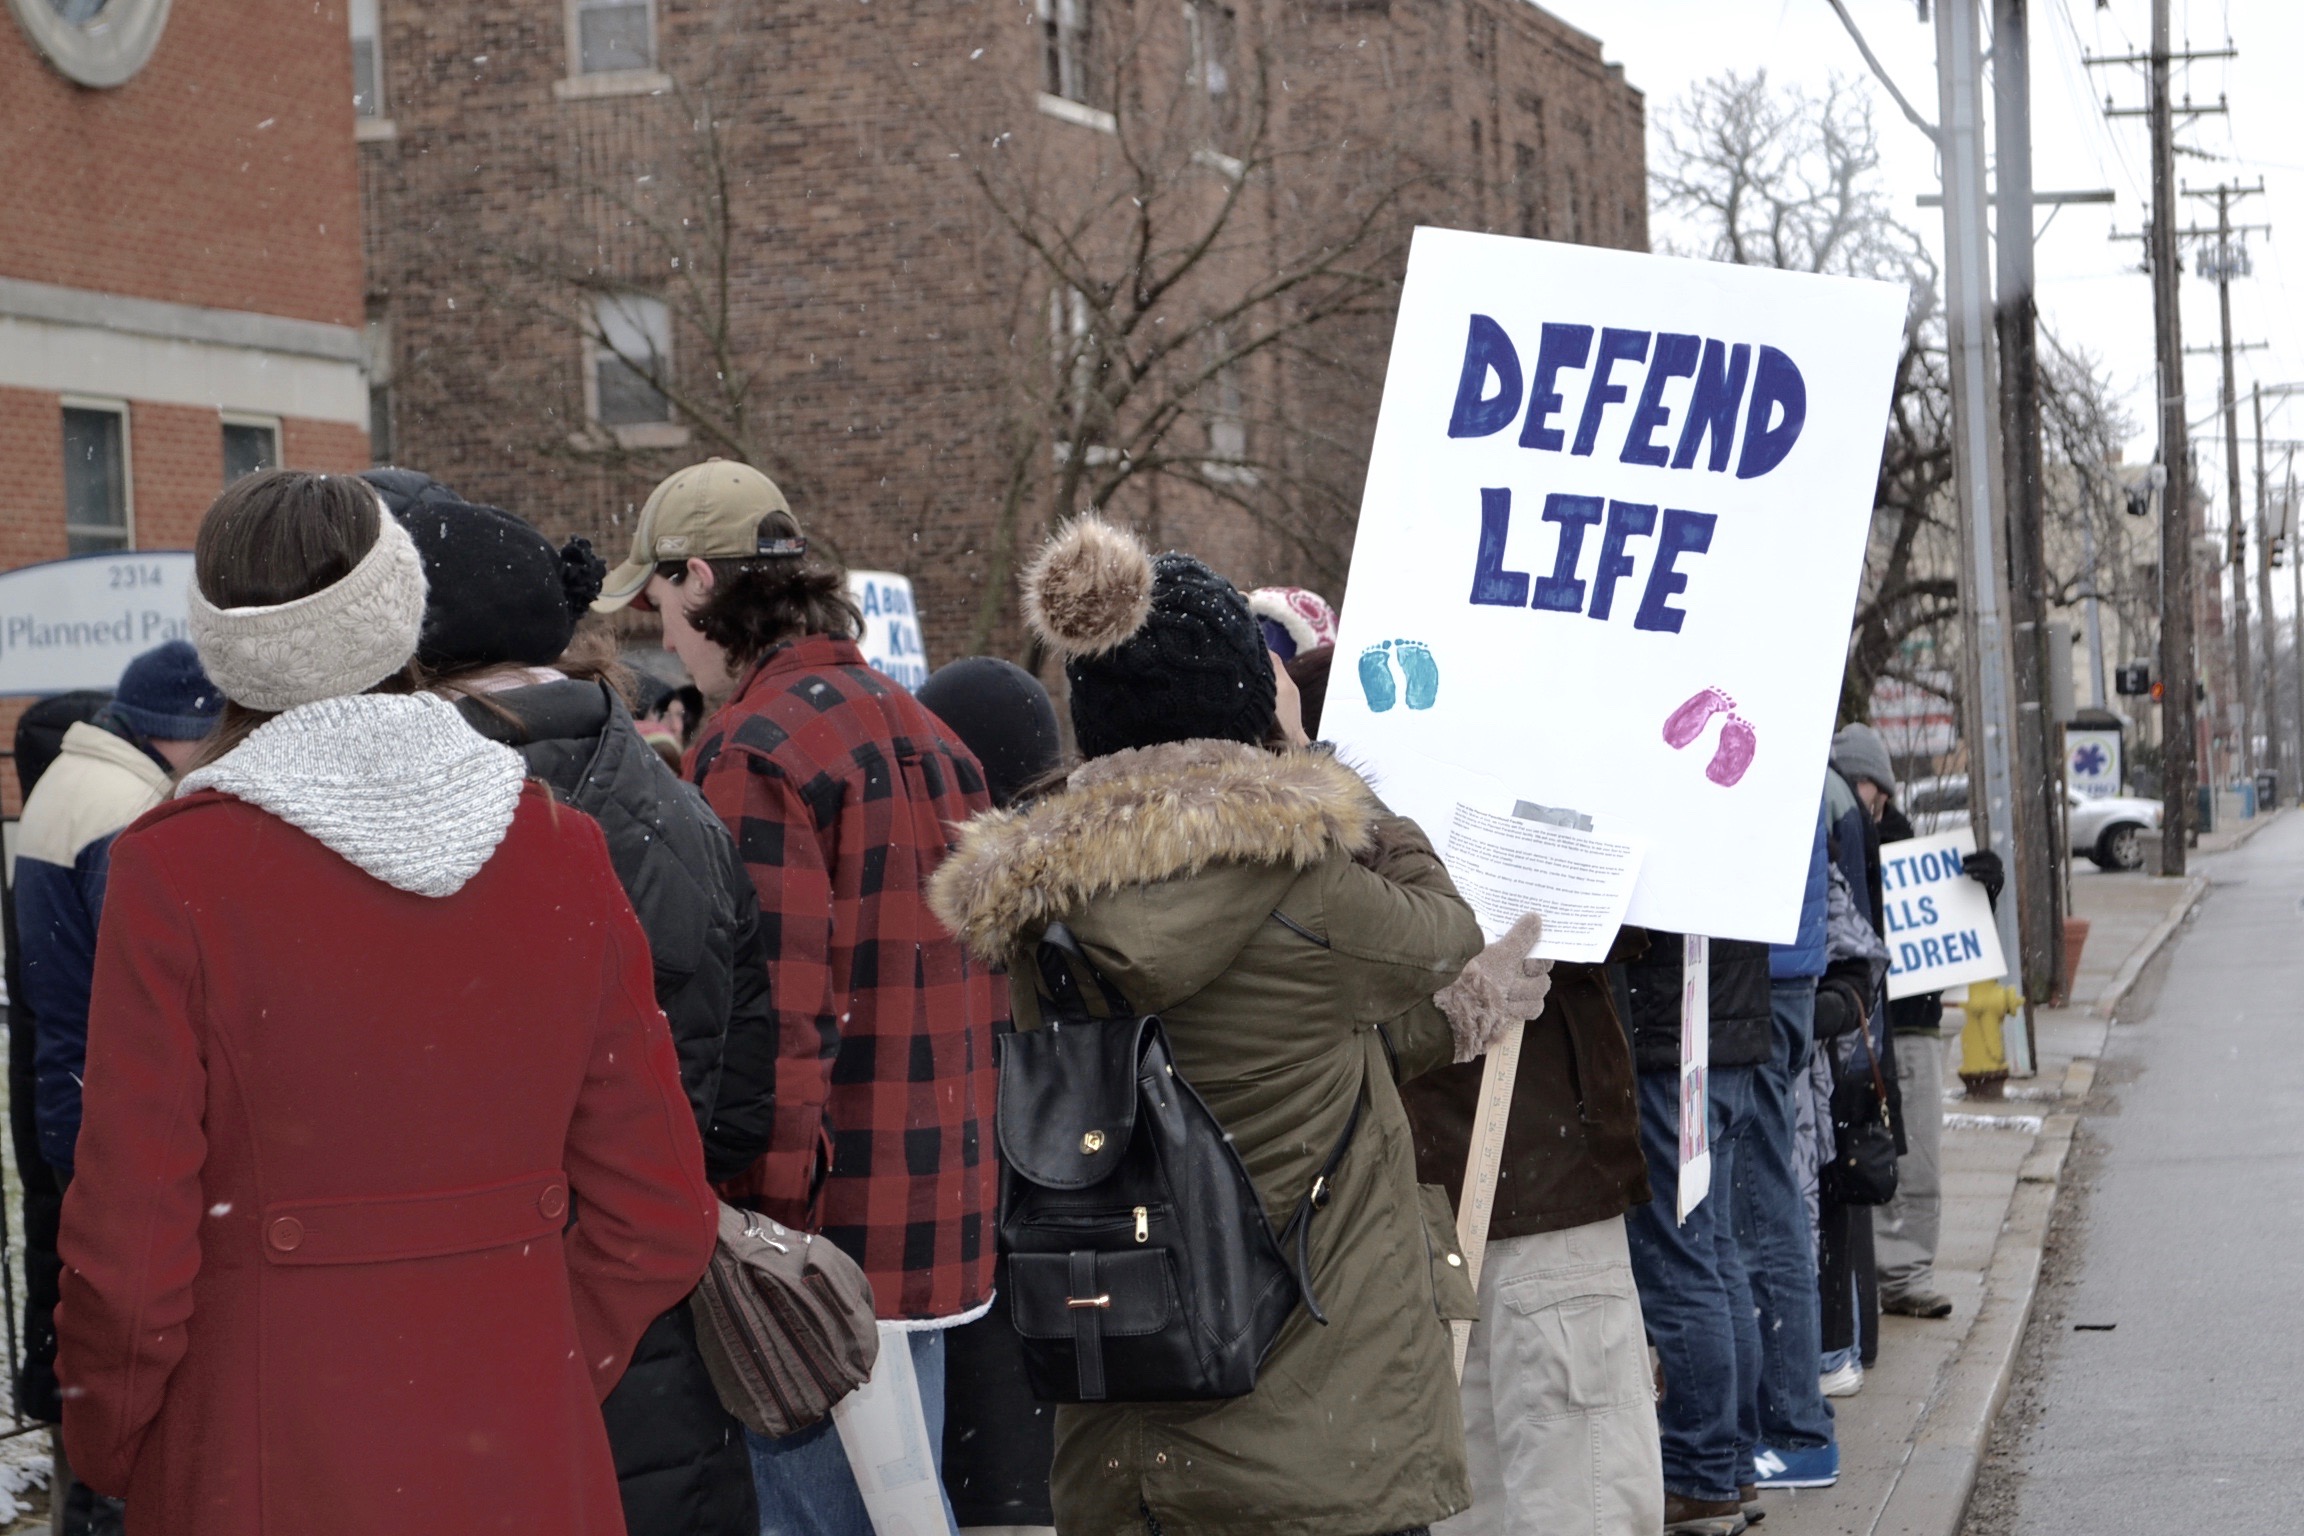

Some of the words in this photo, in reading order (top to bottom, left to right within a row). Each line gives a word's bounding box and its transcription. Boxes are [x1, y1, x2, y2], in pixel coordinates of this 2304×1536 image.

[1448, 314, 1807, 479] DEFEND
[109, 564, 162, 588] 2314
[1469, 487, 1718, 634] LIFE
[8, 611, 132, 649] Planned
[1884, 895, 1939, 932] LLS
